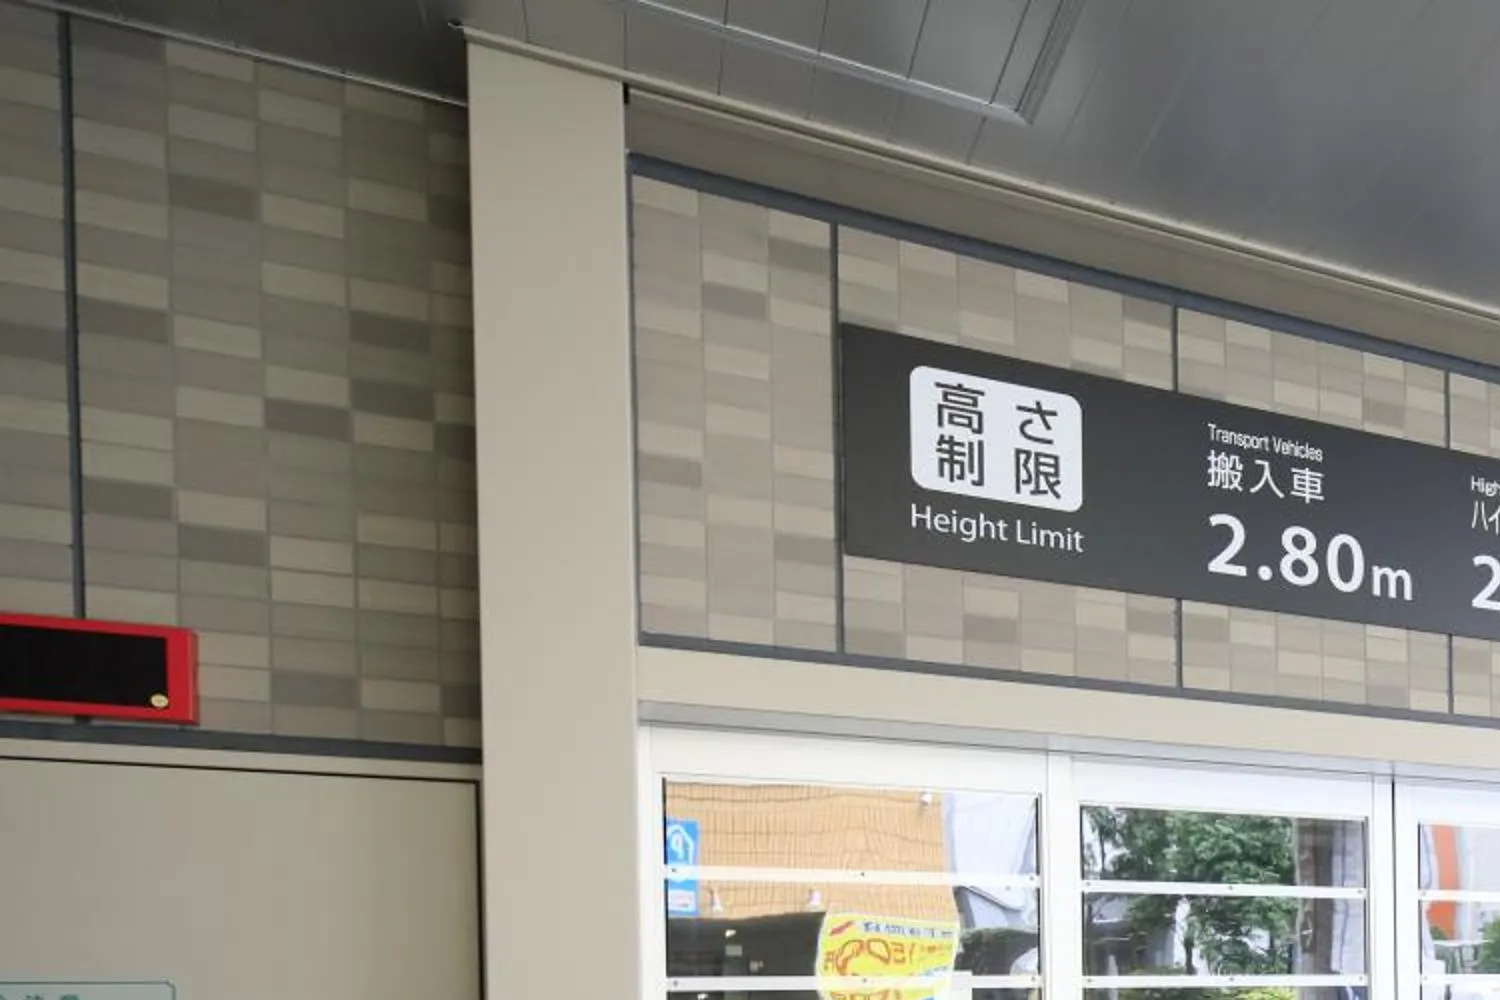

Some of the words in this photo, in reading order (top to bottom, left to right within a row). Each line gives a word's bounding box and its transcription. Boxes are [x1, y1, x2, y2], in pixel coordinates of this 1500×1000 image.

[934, 382, 1058, 445] 高さ
[1207, 423, 1270, 452] Transport
[1272, 436, 1323, 462] Vehicles
[936, 434, 1061, 499] 制限
[1207, 450, 1325, 503] 搬入車
[911, 503, 1008, 543] Height
[1016, 519, 1085, 553] Limit
[1207, 513, 1413, 601] 2.80m
